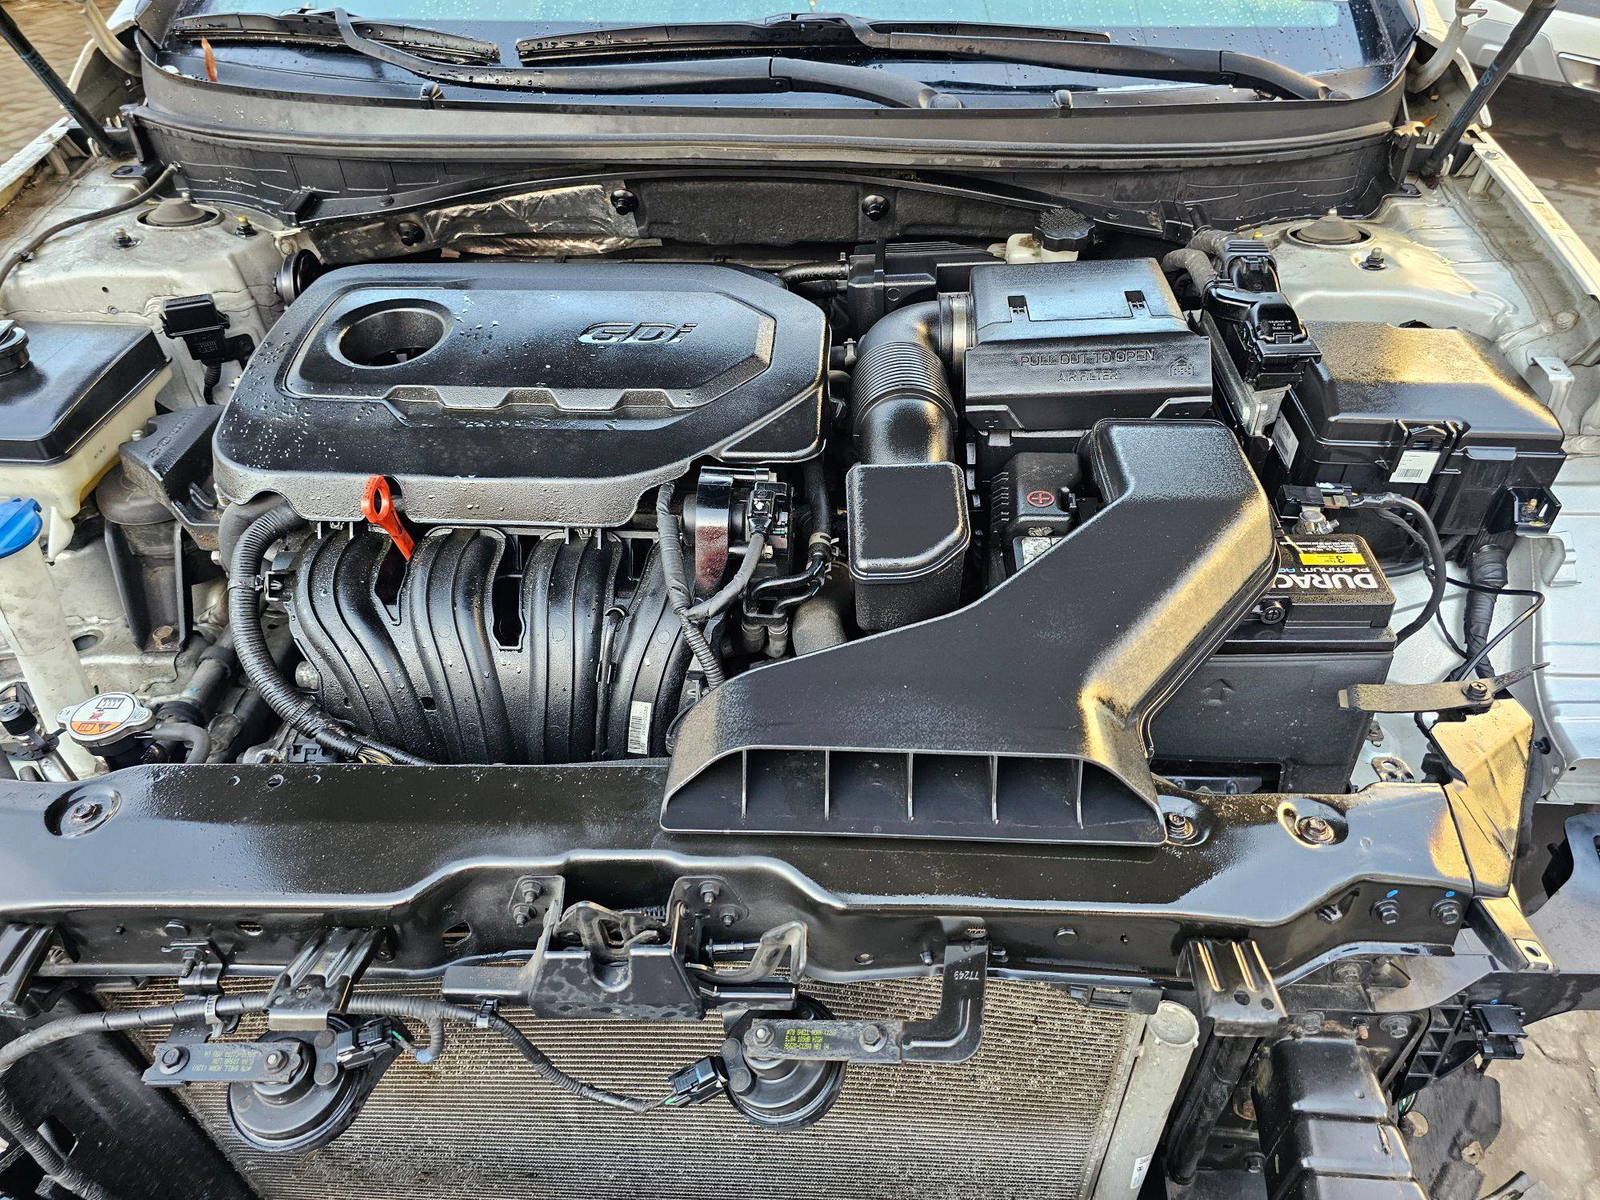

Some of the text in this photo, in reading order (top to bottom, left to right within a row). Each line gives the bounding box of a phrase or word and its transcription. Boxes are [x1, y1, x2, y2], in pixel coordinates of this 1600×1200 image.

[1020, 349, 1156, 367] PULL OUT TO OPEN
[1335, 555, 1345, 564] 3
[1271, 573, 1379, 589] DURAC
